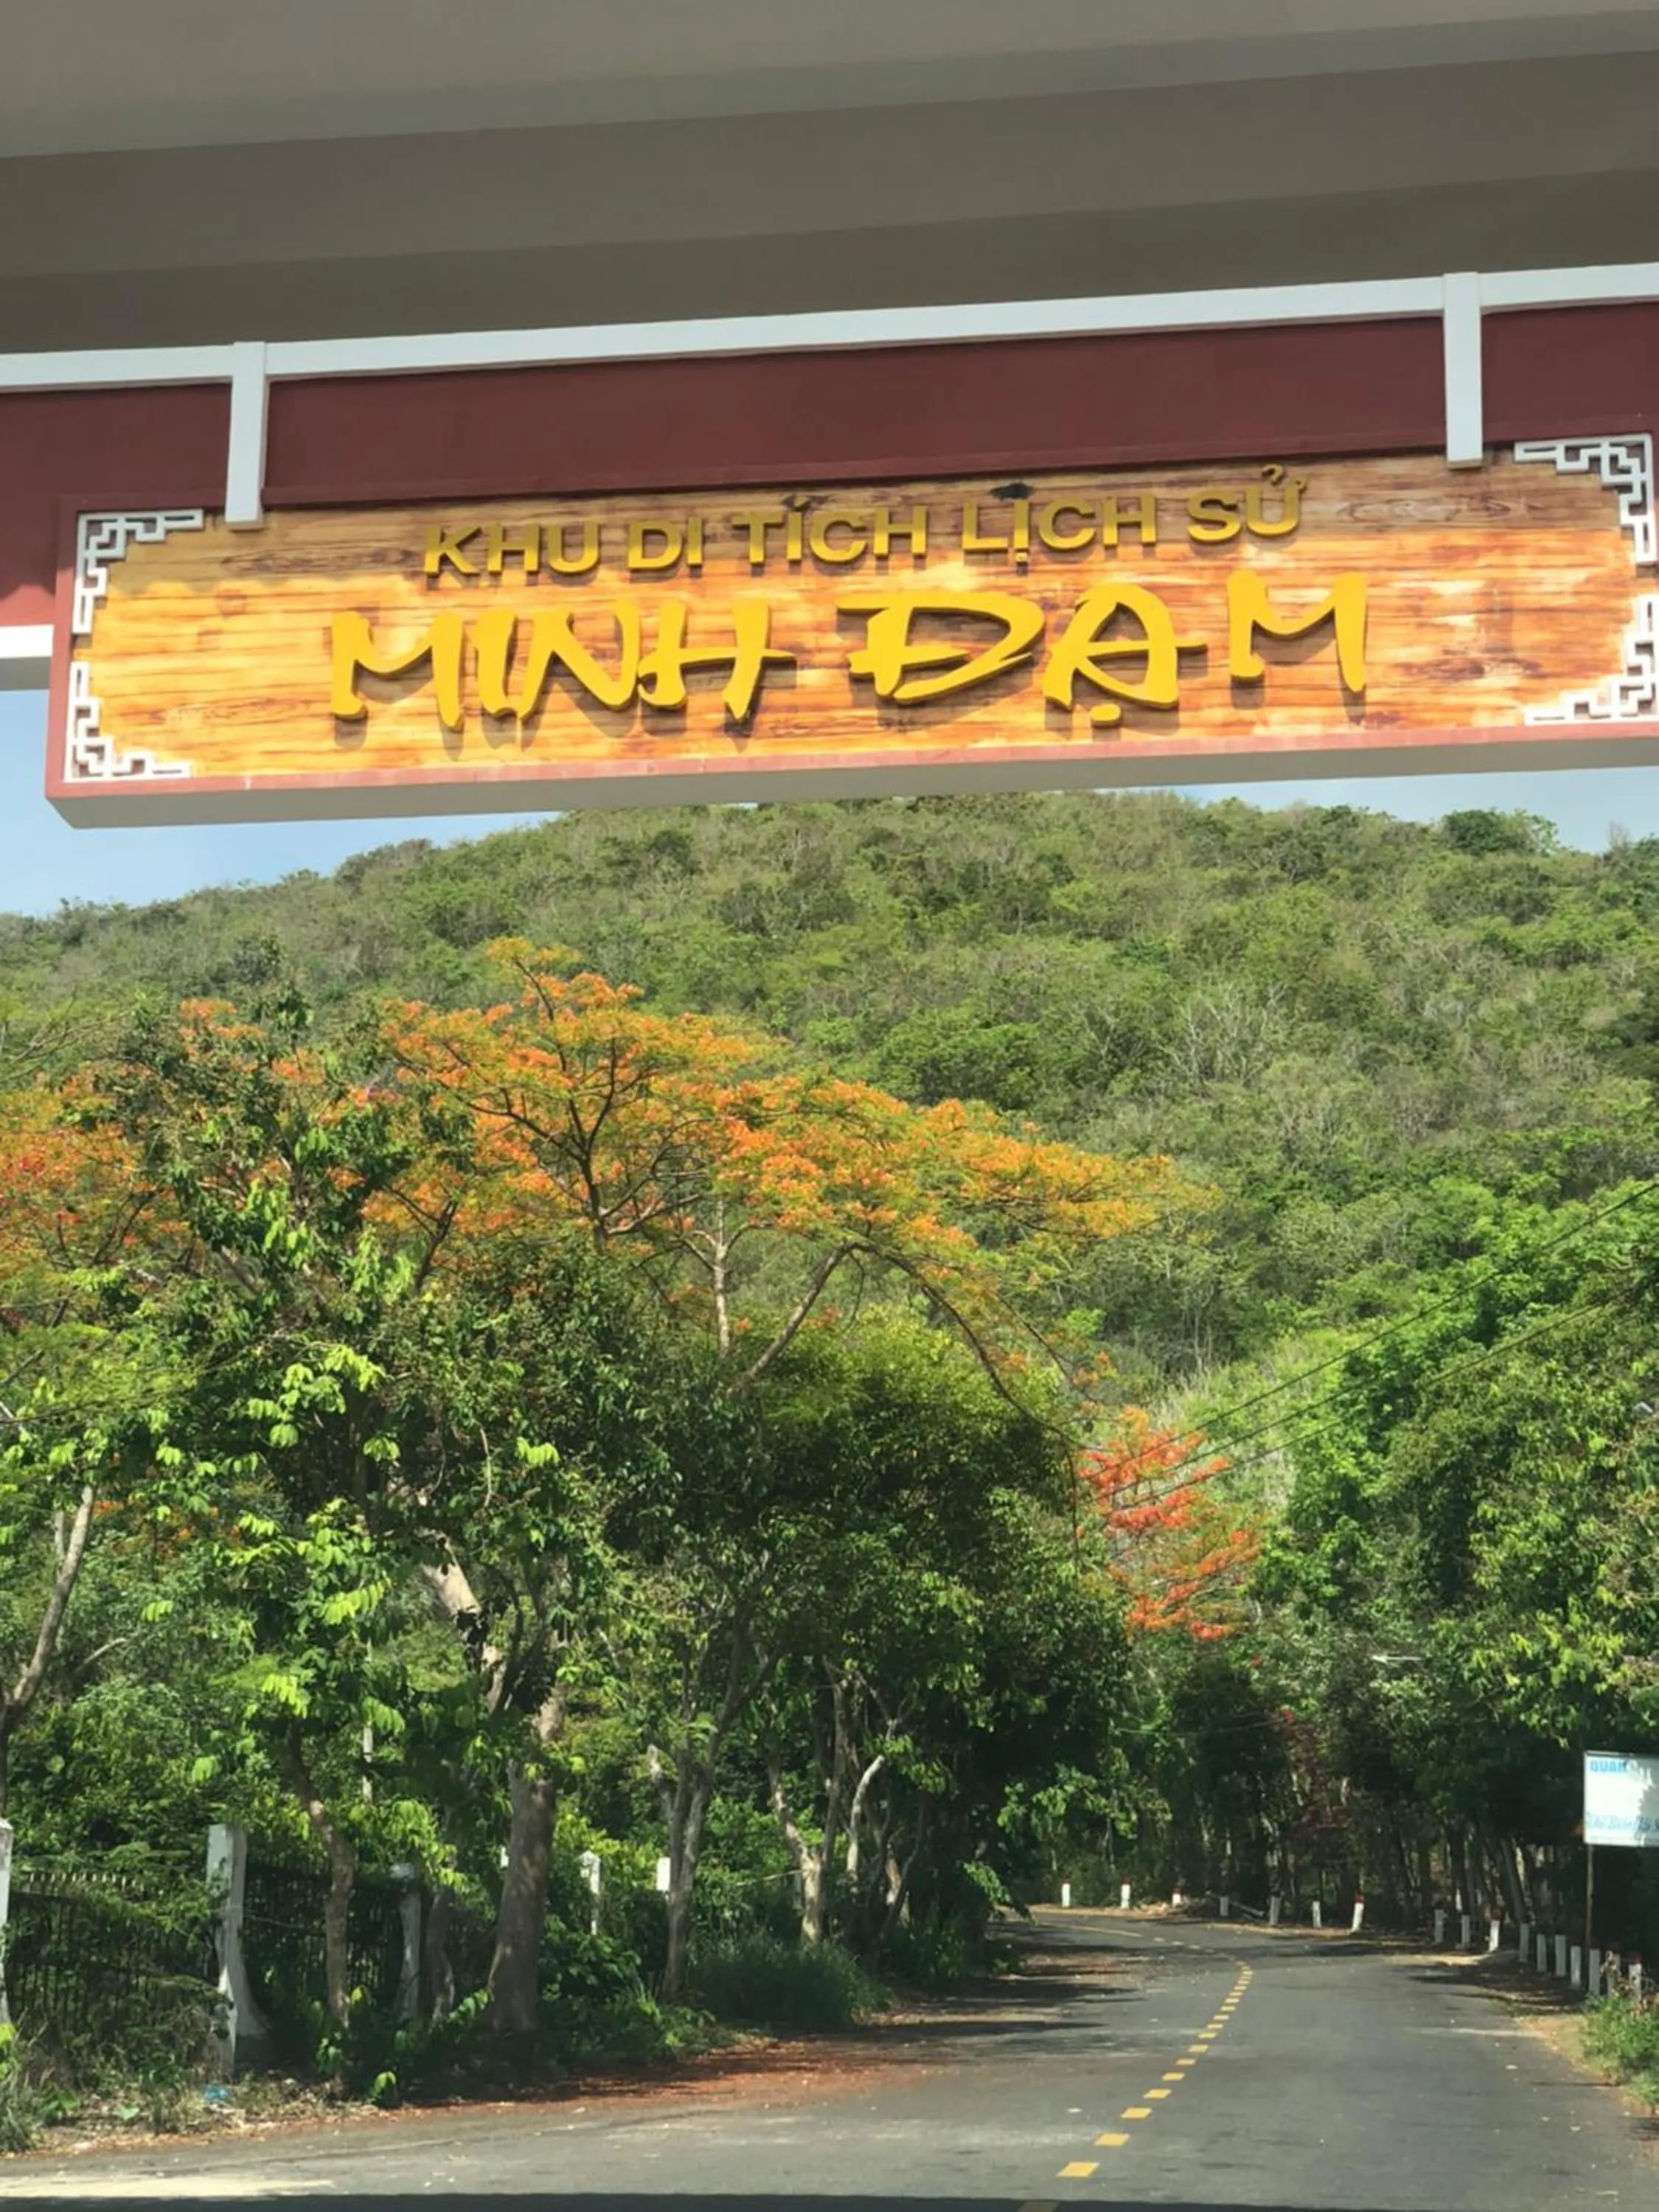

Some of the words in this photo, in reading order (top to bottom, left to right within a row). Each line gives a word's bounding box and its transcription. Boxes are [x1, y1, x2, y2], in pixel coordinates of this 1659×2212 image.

[424, 521, 600, 577] KHU
[627, 516, 703, 570] DI
[732, 494, 928, 566] TÍCH
[961, 494, 1157, 564] LỊCH
[1186, 463, 1309, 542] SỬ
[330, 598, 797, 730] MINH
[835, 570, 1368, 726] ĐẠM
